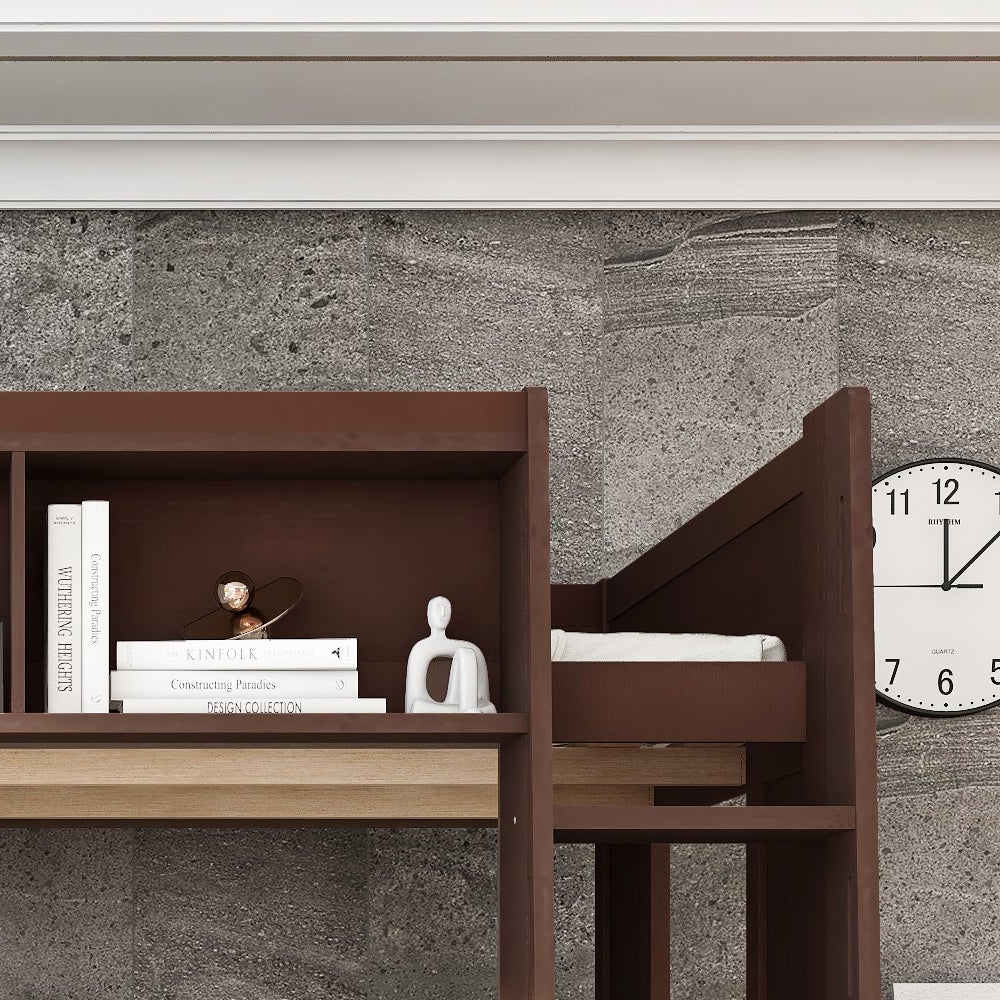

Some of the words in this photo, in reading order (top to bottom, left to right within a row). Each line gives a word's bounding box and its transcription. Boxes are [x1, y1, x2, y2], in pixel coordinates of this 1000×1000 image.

[886, 488, 910, 515] 11
[932, 478, 959, 504] 12
[57, 566, 73, 637] WUTHERING
[57, 643, 73, 692] HEIGHTS
[186, 648, 258, 661] KINFOLK
[884, 658, 900, 685] 7
[938, 668, 954, 695] 6
[990, 658, 1000, 685] 5
[170, 679, 233, 692] Constructing
[207, 701, 242, 713] DESIGN
[245, 701, 302, 713] COLLECTION
